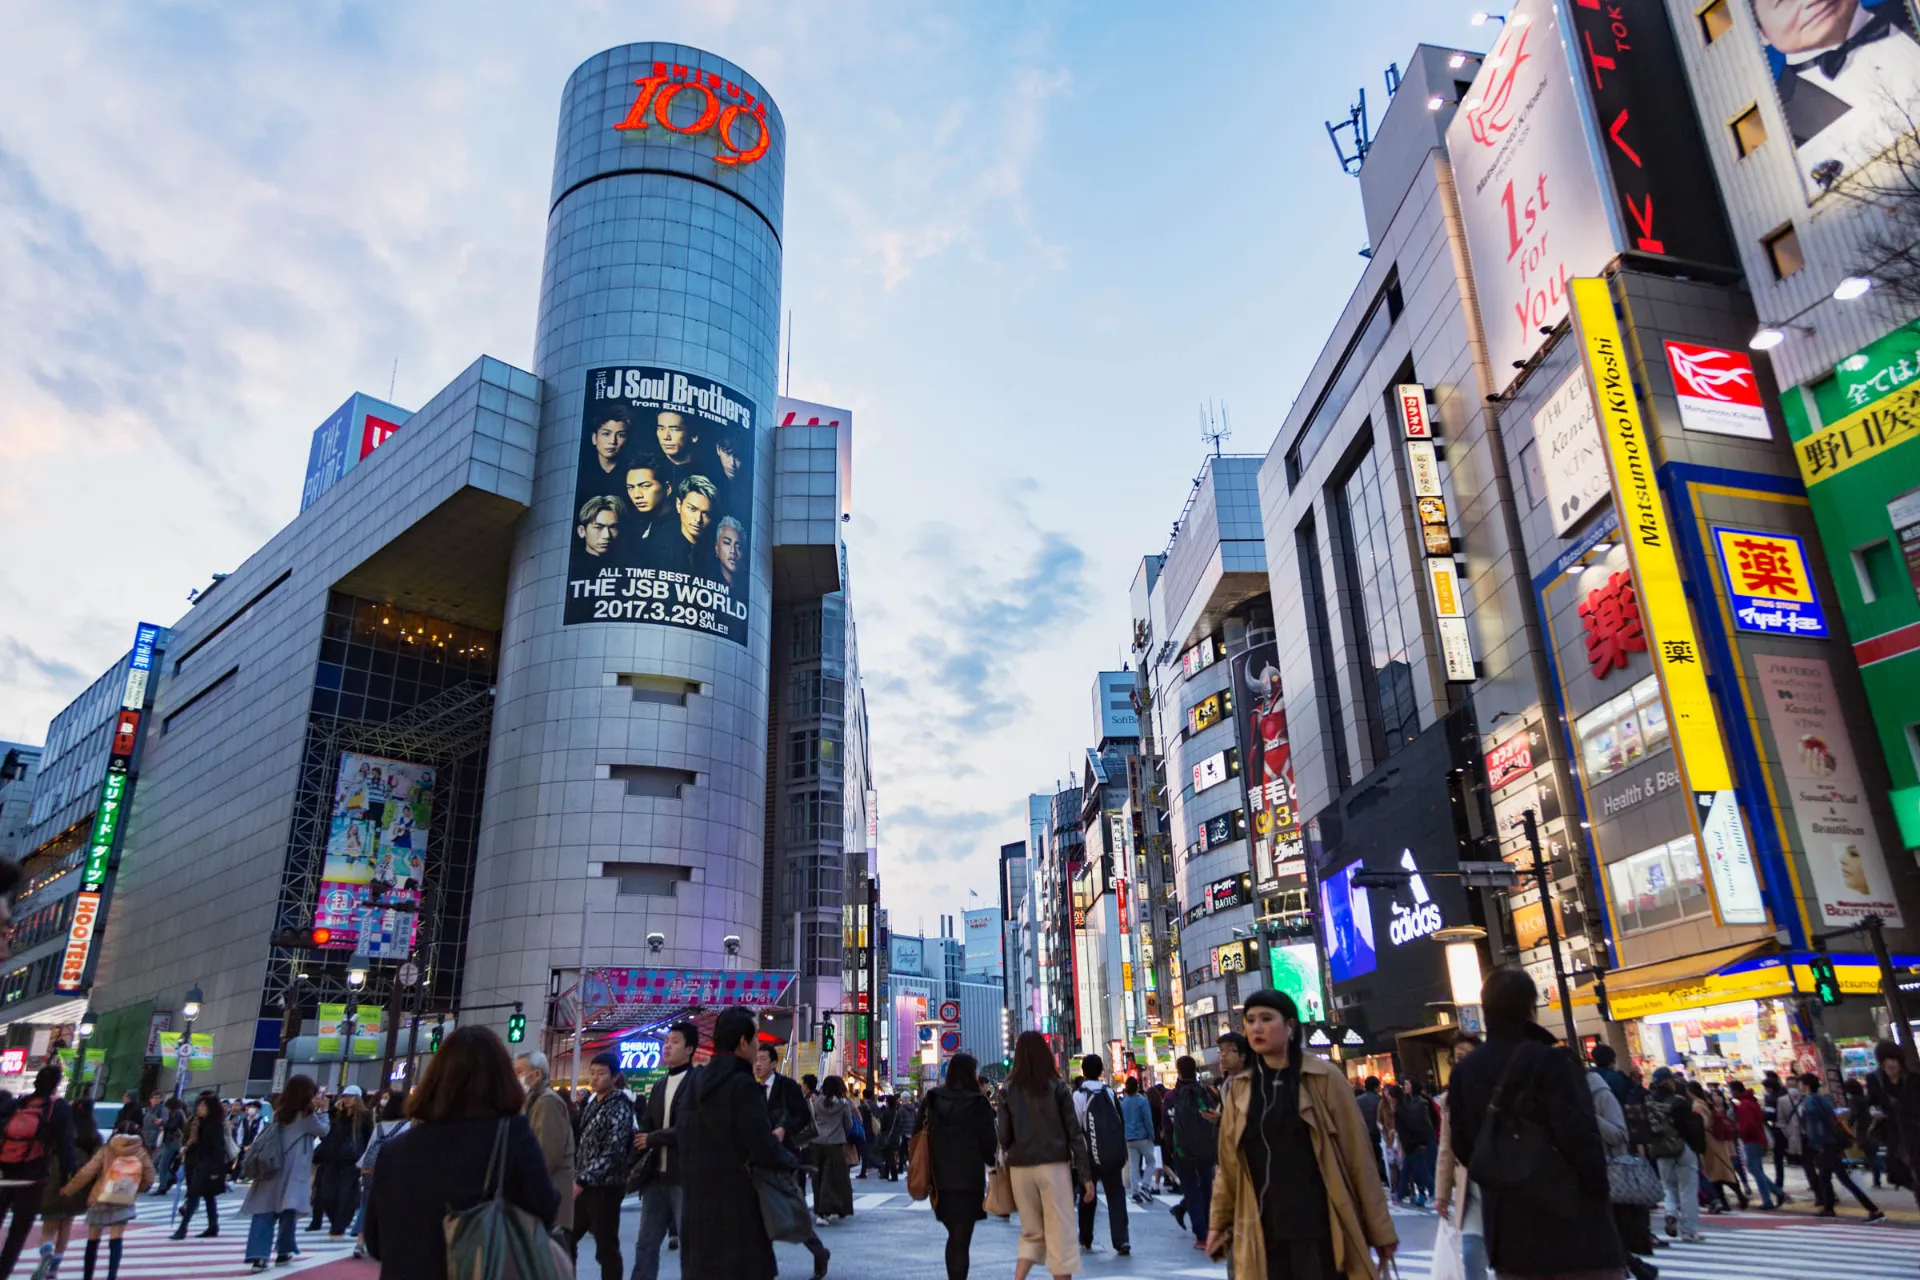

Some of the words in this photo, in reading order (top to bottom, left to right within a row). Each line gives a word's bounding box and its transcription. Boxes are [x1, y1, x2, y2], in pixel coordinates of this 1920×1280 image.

[653, 61, 767, 119] SHIBUYA
[613, 75, 770, 165] 109
[607, 370, 623, 398] J
[625, 369, 669, 402] Soul
[672, 372, 750, 430] Brothers
[631, 399, 660, 409] from
[663, 403, 695, 415] EXILE
[698, 410, 728, 426] TRIBE
[1407, 398, 1421, 433] カラオケ
[318, 417, 342, 468] THE
[1618, 418, 1661, 547] Matsumoto
[598, 567, 622, 578] ALL
[625, 567, 656, 579] TIME
[658, 570, 690, 583] BEST
[692, 577, 729, 596] ALBUM
[1733, 538, 1799, 596] 薬
[570, 579, 616, 599] THE
[621, 580, 669, 600] JSB
[674, 583, 748, 621] WORLD
[593, 600, 698, 625] 2017.3.29
[700, 610, 715, 622] ON
[1577, 569, 1647, 680] 薬
[1663, 640, 1695, 665] 薬
[1604, 784, 1642, 815] Health
[1644, 778, 1654, 796] &
[1214, 894, 1238, 910] BAGUS
[64, 900, 97, 982] HOOTERS
[1390, 902, 1442, 945] adidas
[943, 1008, 955, 1017] 30
[621, 1042, 661, 1052] SHIBUYA
